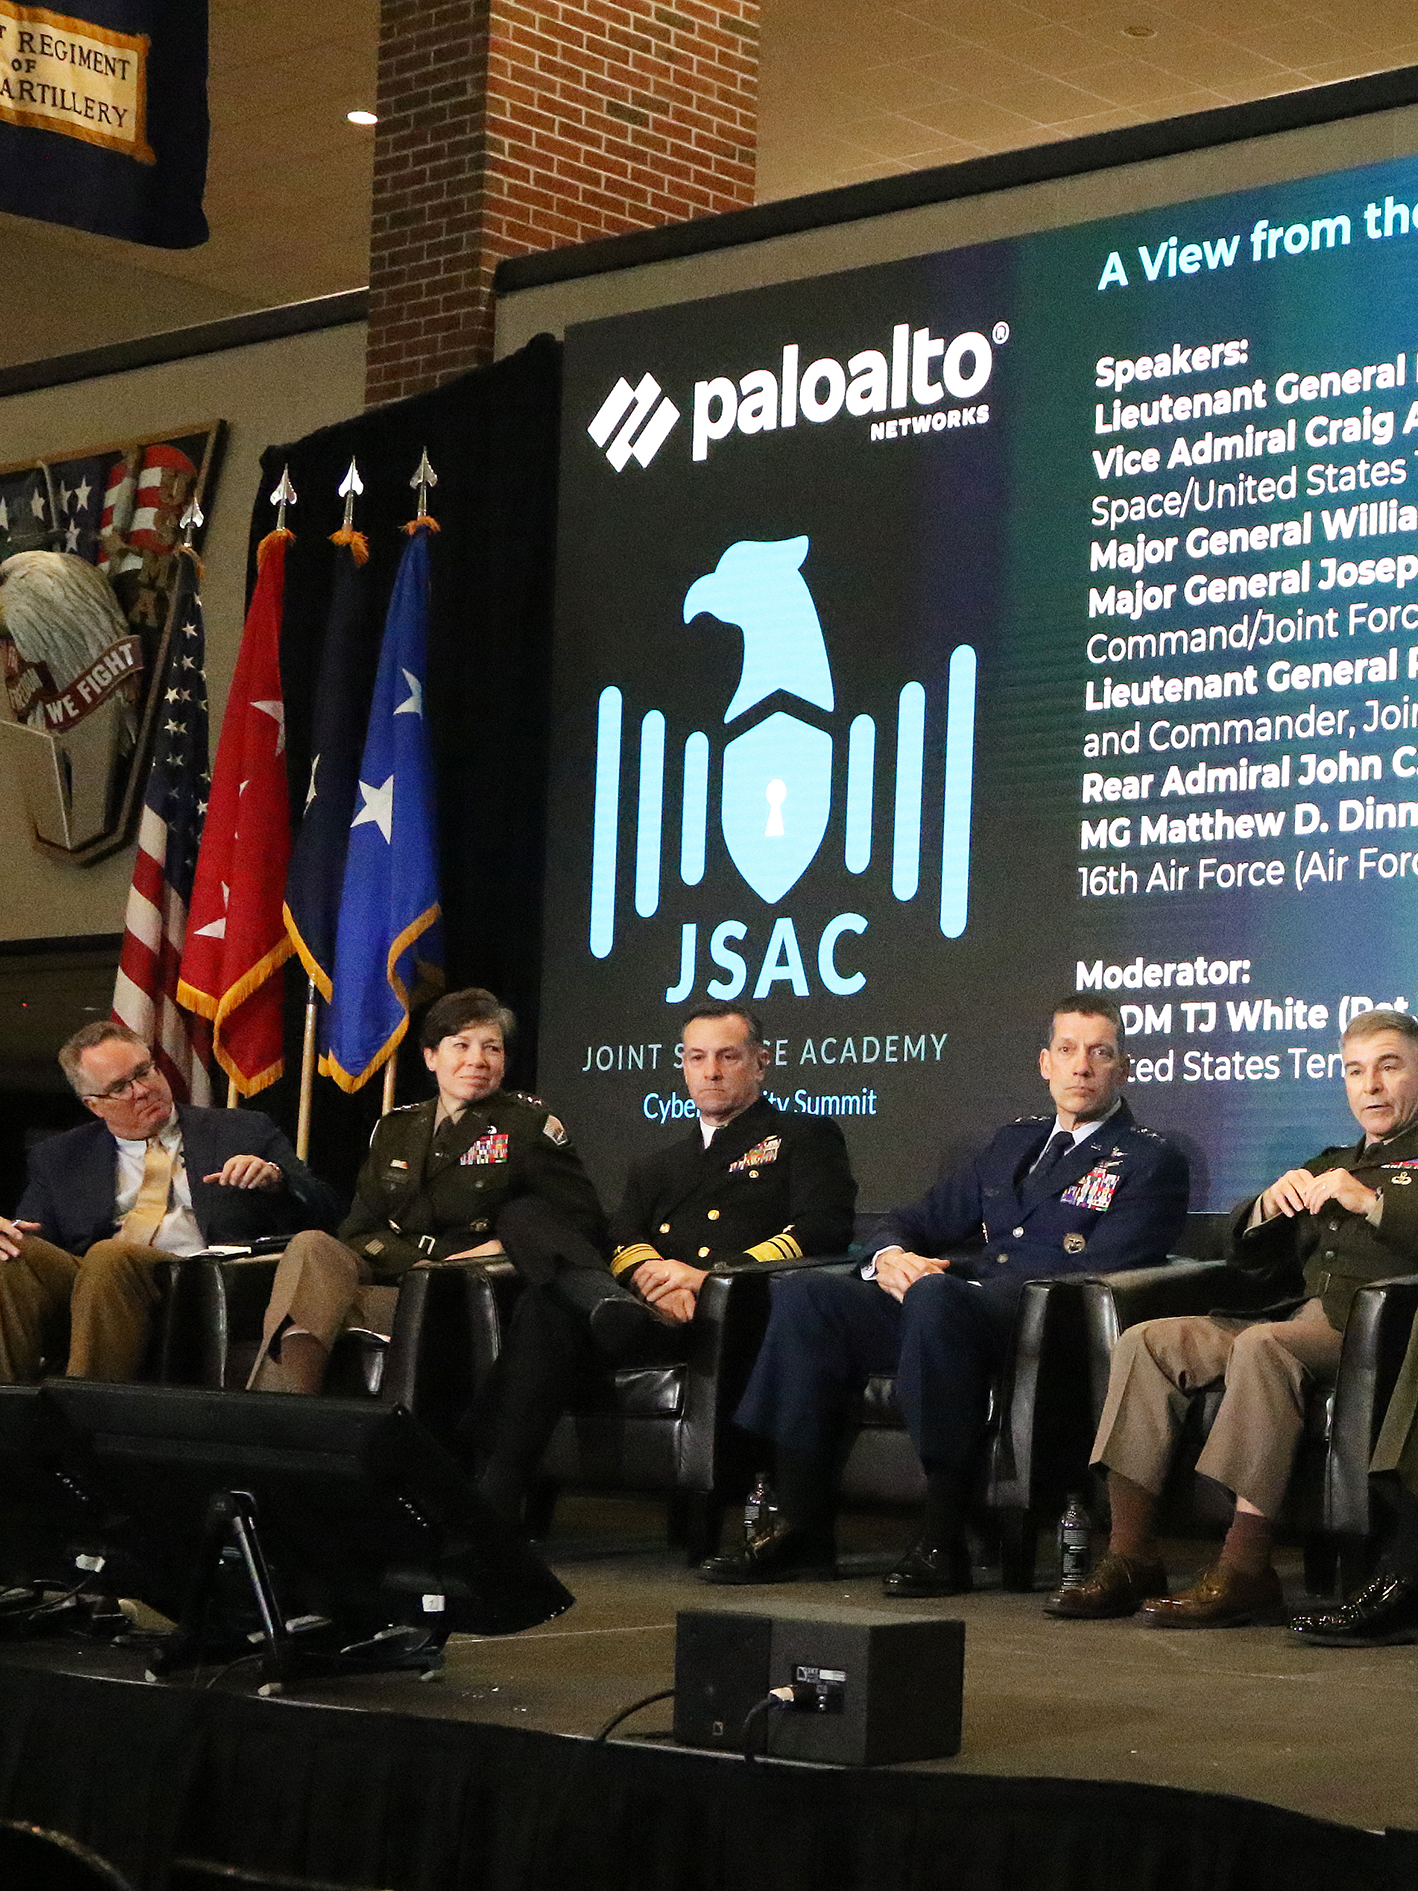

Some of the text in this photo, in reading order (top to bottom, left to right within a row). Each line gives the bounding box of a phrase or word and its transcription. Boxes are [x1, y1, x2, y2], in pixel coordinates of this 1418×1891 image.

[11, 58, 37, 73] OF
[17, 30, 131, 80] REGIMENT
[0, 78, 128, 128] ARTILLERY
[1097, 251, 1129, 291] A
[1138, 234, 1241, 281] View
[1250, 214, 1351, 262] from
[1095, 338, 1249, 393] Speakers:
[1094, 378, 1268, 435] Lieutenant
[1275, 352, 1406, 405] General
[870, 404, 990, 441] NETWORKS
[1092, 444, 1161, 480] Vice
[1166, 418, 1297, 470] Admiral
[1304, 405, 1395, 448] Craig
[1091, 465, 1297, 531] Space/United
[1305, 458, 1407, 496] States
[1089, 533, 1179, 574] Major
[1185, 510, 1312, 559] General
[1088, 579, 1177, 621] Major
[1183, 559, 1311, 606] General
[1086, 607, 1339, 664] Command/Joint
[46, 643, 134, 724] WE FIGHT
[1085, 664, 1259, 712] Lieutenant
[1266, 647, 1398, 693] General
[1083, 720, 1141, 758] and
[1148, 703, 1356, 752] Commander,
[1082, 772, 1155, 804] Rear
[1160, 754, 1291, 798] Admiral
[1297, 749, 1383, 786] John
[1080, 816, 1131, 851] MG
[1139, 808, 1286, 846] Matthew
[1294, 802, 1330, 836] D.
[1077, 862, 1138, 897] 16th
[1145, 858, 1190, 893] Air
[1198, 857, 1286, 890] Force
[1294, 848, 1349, 892] (Air
[665, 912, 869, 1003] JSAC
[1075, 956, 1251, 991] Moderator:
[1180, 1001, 1217, 1034] TJ
[1226, 996, 1329, 1032] White
[581, 1043, 663, 1073] JOINT
[799, 1033, 949, 1067] ACADEMY
[1182, 1050, 1281, 1083] States
[1288, 1047, 1344, 1080] Ten
[794, 1086, 878, 1116] Summit
